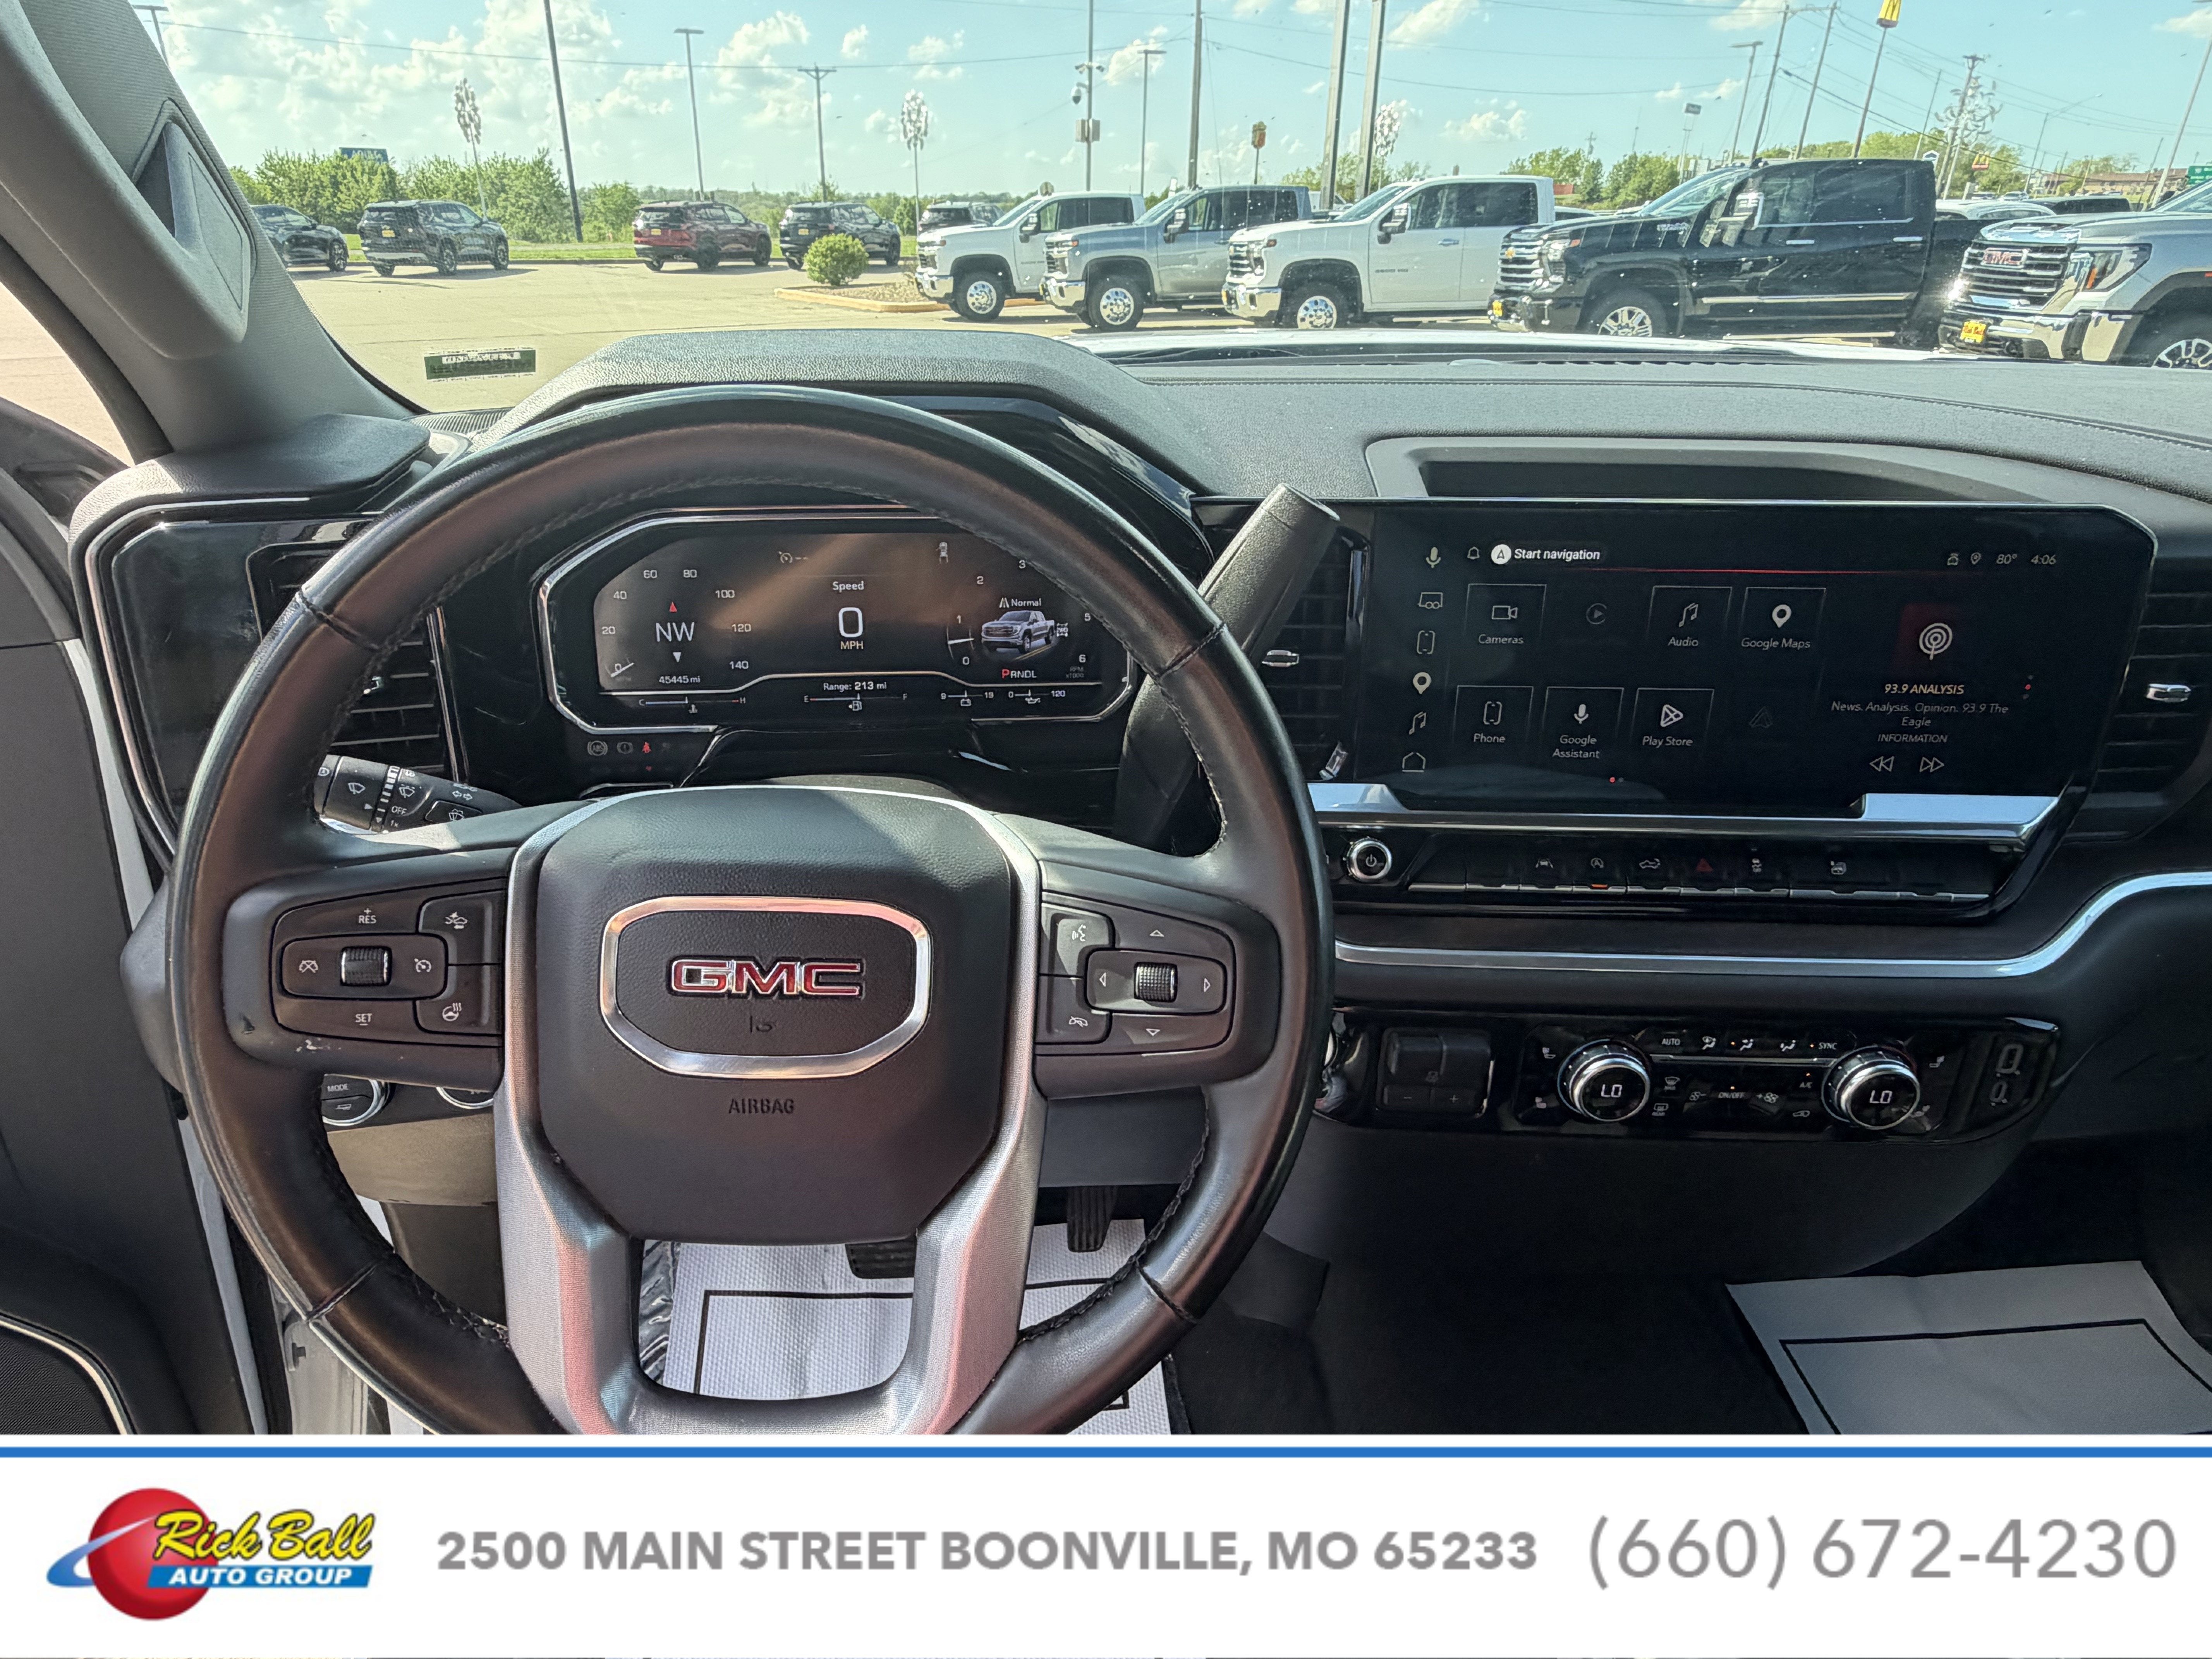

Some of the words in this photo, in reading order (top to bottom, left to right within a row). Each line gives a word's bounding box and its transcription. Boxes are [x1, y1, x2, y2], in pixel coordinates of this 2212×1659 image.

[1515, 549, 1540, 559] Start
[1543, 550, 1600, 562] navigation
[2031, 555, 2056, 564] 4:06
[1018, 560, 1026, 568] 3
[643, 570, 658, 579] 60
[683, 570, 697, 578] 80
[977, 576, 984, 585] 2
[832, 581, 864, 592] Speed
[613, 591, 627, 600] 40
[716, 590, 735, 598] 100
[1011, 598, 1042, 607] Normal
[838, 607, 863, 637] 0
[957, 615, 962, 623] 1
[602, 626, 615, 634] 20
[656, 622, 695, 642] NW
[732, 624, 751, 632] 120
[1479, 634, 1524, 644] Cameras
[1668, 636, 1699, 647] Audio
[1741, 638, 1779, 650] Google
[1781, 639, 1811, 650] Maps
[840, 641, 864, 649] MPH
[730, 661, 749, 670] 140
[659, 675, 689, 684] 45445
[823, 683, 852, 692] Range:
[854, 682, 874, 690] 213
[1884, 684, 1908, 694] 93.9
[1910, 685, 1964, 694] ANALYSIS
[1831, 701, 1863, 712] News.
[1865, 702, 1911, 714] Analysis.
[1915, 703, 1958, 714] Opinion.
[1962, 704, 1985, 713] 93.9
[1989, 704, 2008, 713] The
[1901, 716, 1932, 729] Eagle
[1474, 733, 1506, 744] Phone
[1560, 735, 1597, 747] Google
[1642, 736, 1663, 748] Play
[1665, 737, 1693, 746] Store
[1877, 734, 1948, 743] INFORMATION
[1553, 749, 1599, 759] Assistant
[392, 805, 407, 815] OFF
[359, 915, 376, 924] RES
[671, 959, 861, 996] GMC
[355, 1013, 372, 1022] SET
[327, 1084, 349, 1092] MODE
[1601, 1084, 1623, 1098] LO
[1869, 1090, 1893, 1104] LO
[728, 1098, 795, 1115] AIRBAG
